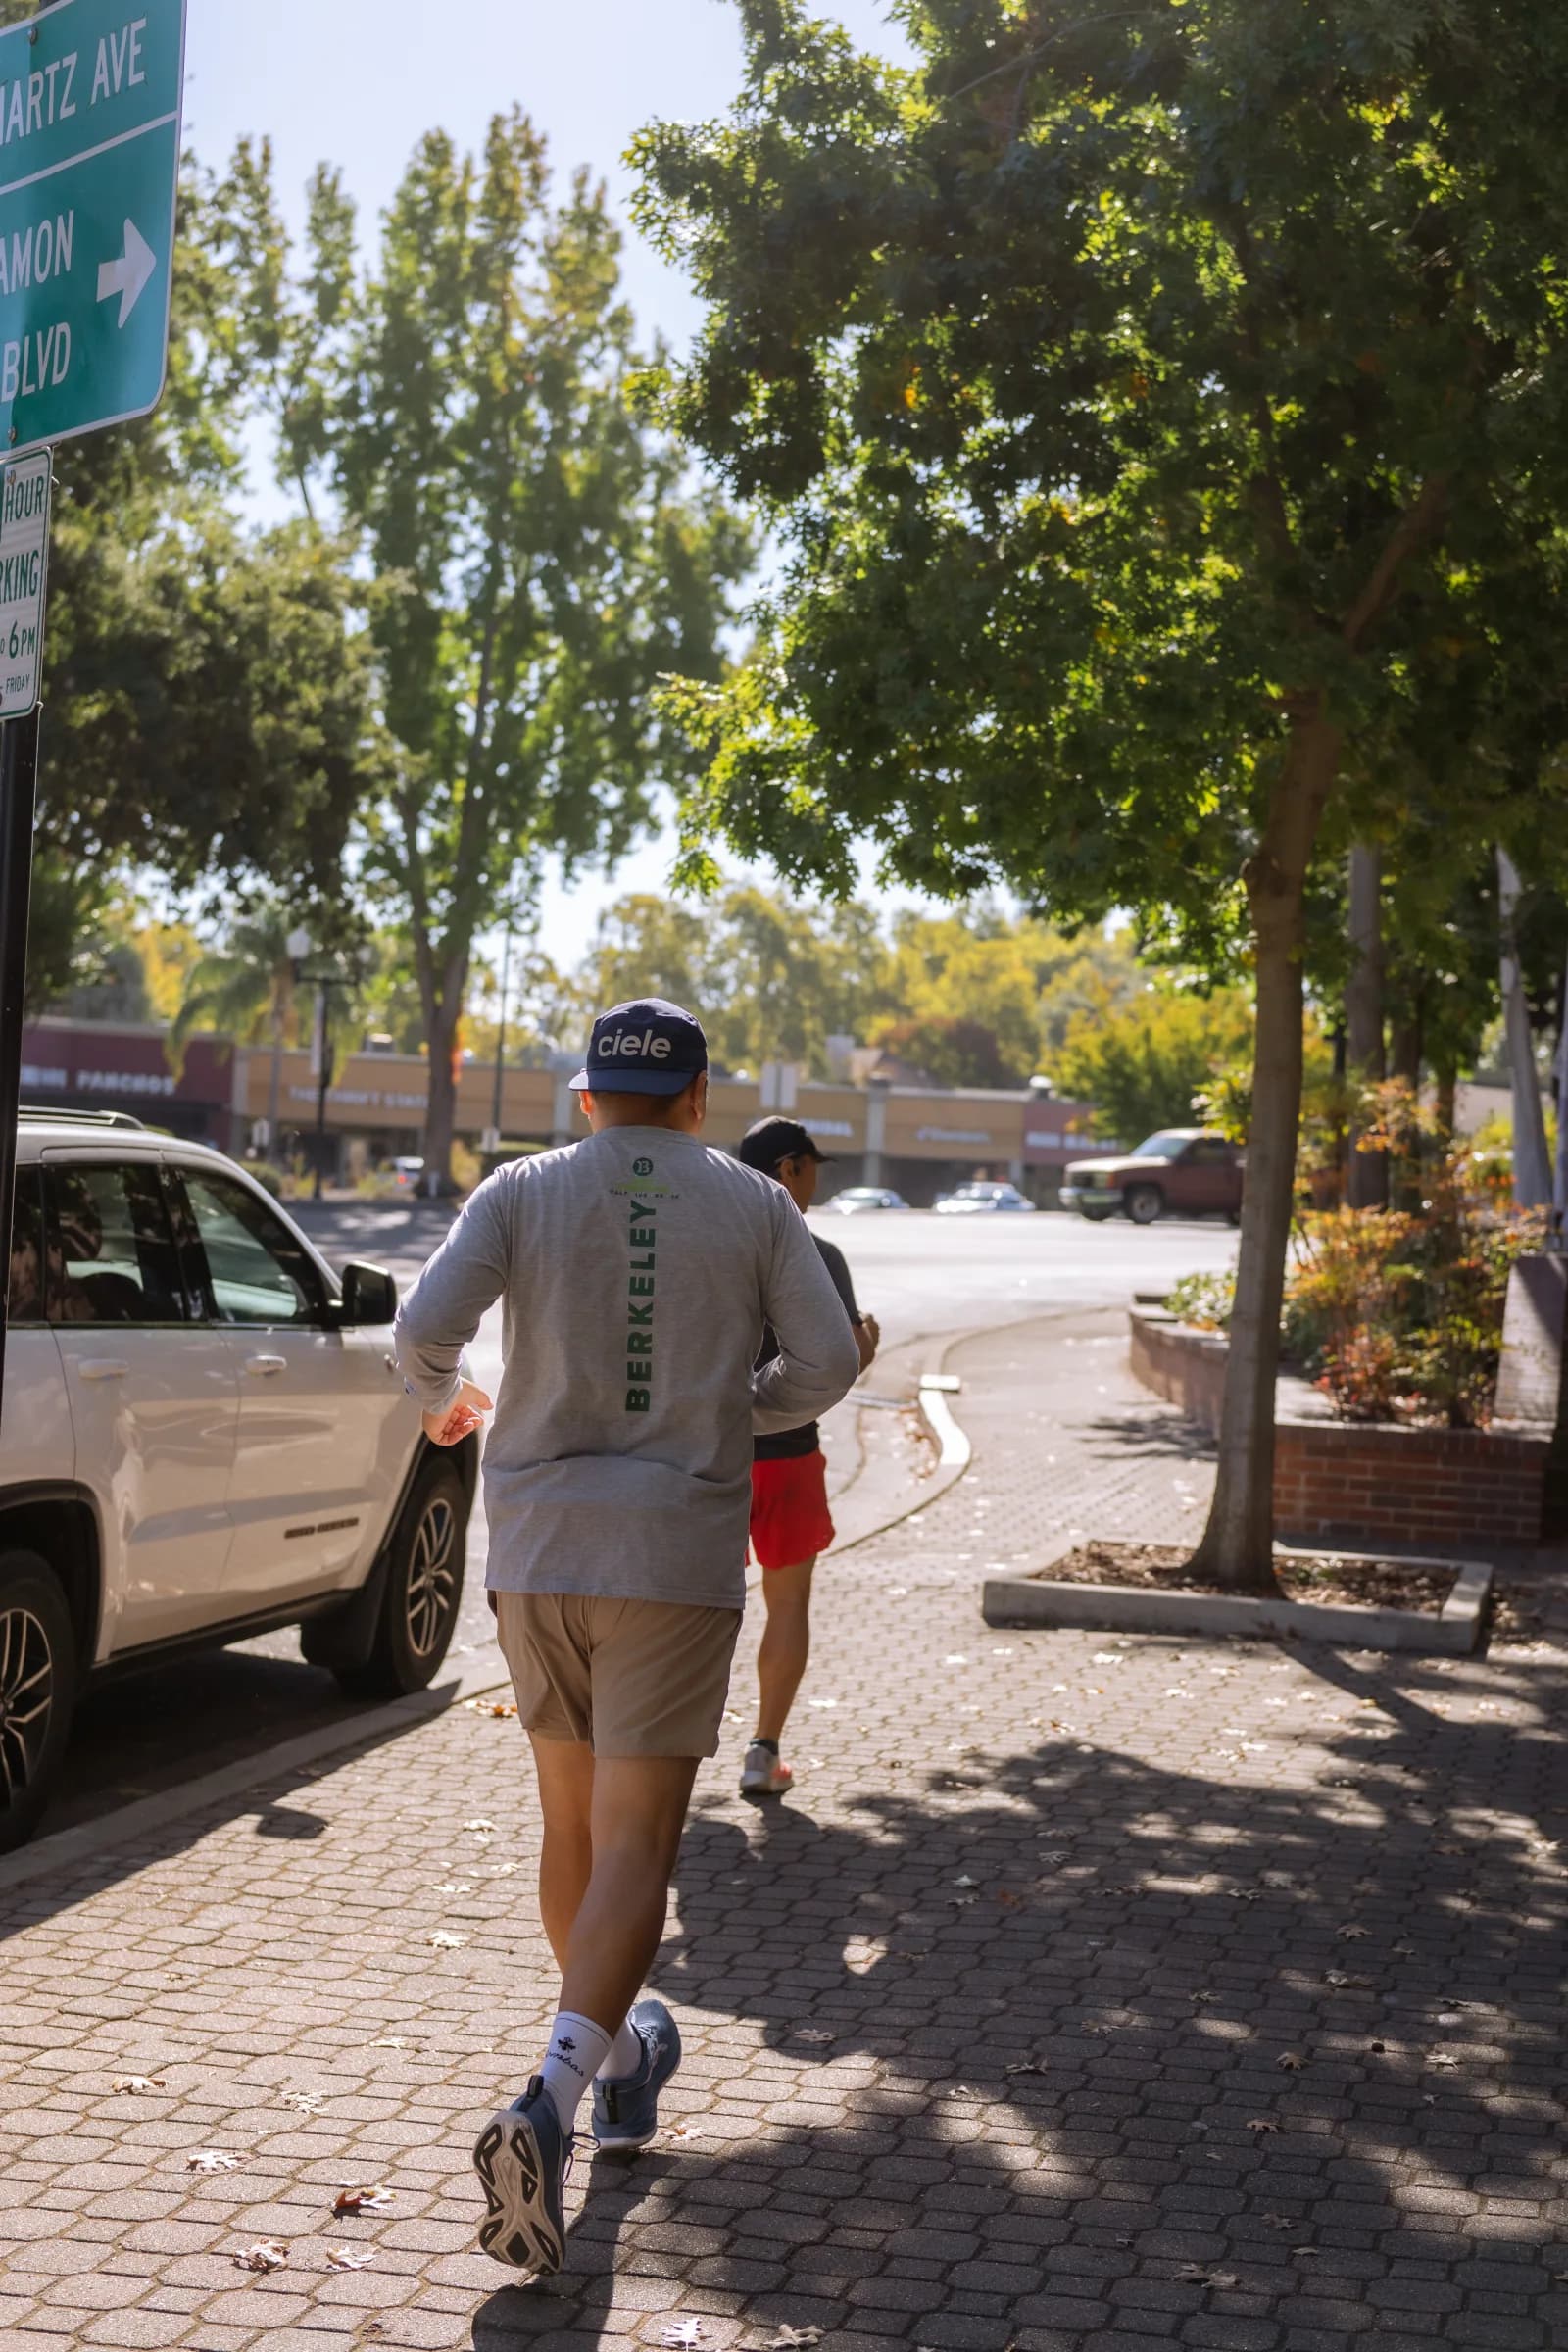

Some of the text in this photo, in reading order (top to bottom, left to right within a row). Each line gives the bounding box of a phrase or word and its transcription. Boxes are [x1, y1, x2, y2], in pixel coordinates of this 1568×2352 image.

[90, 18, 146, 105] AVE
[1, 322, 71, 402] BLVD
[5, 475, 44, 523] HOUR
[6, 674, 30, 694] FRIDAY
[598, 1029, 671, 1059] ciele
[625, 1200, 656, 1412] BERKELEY
